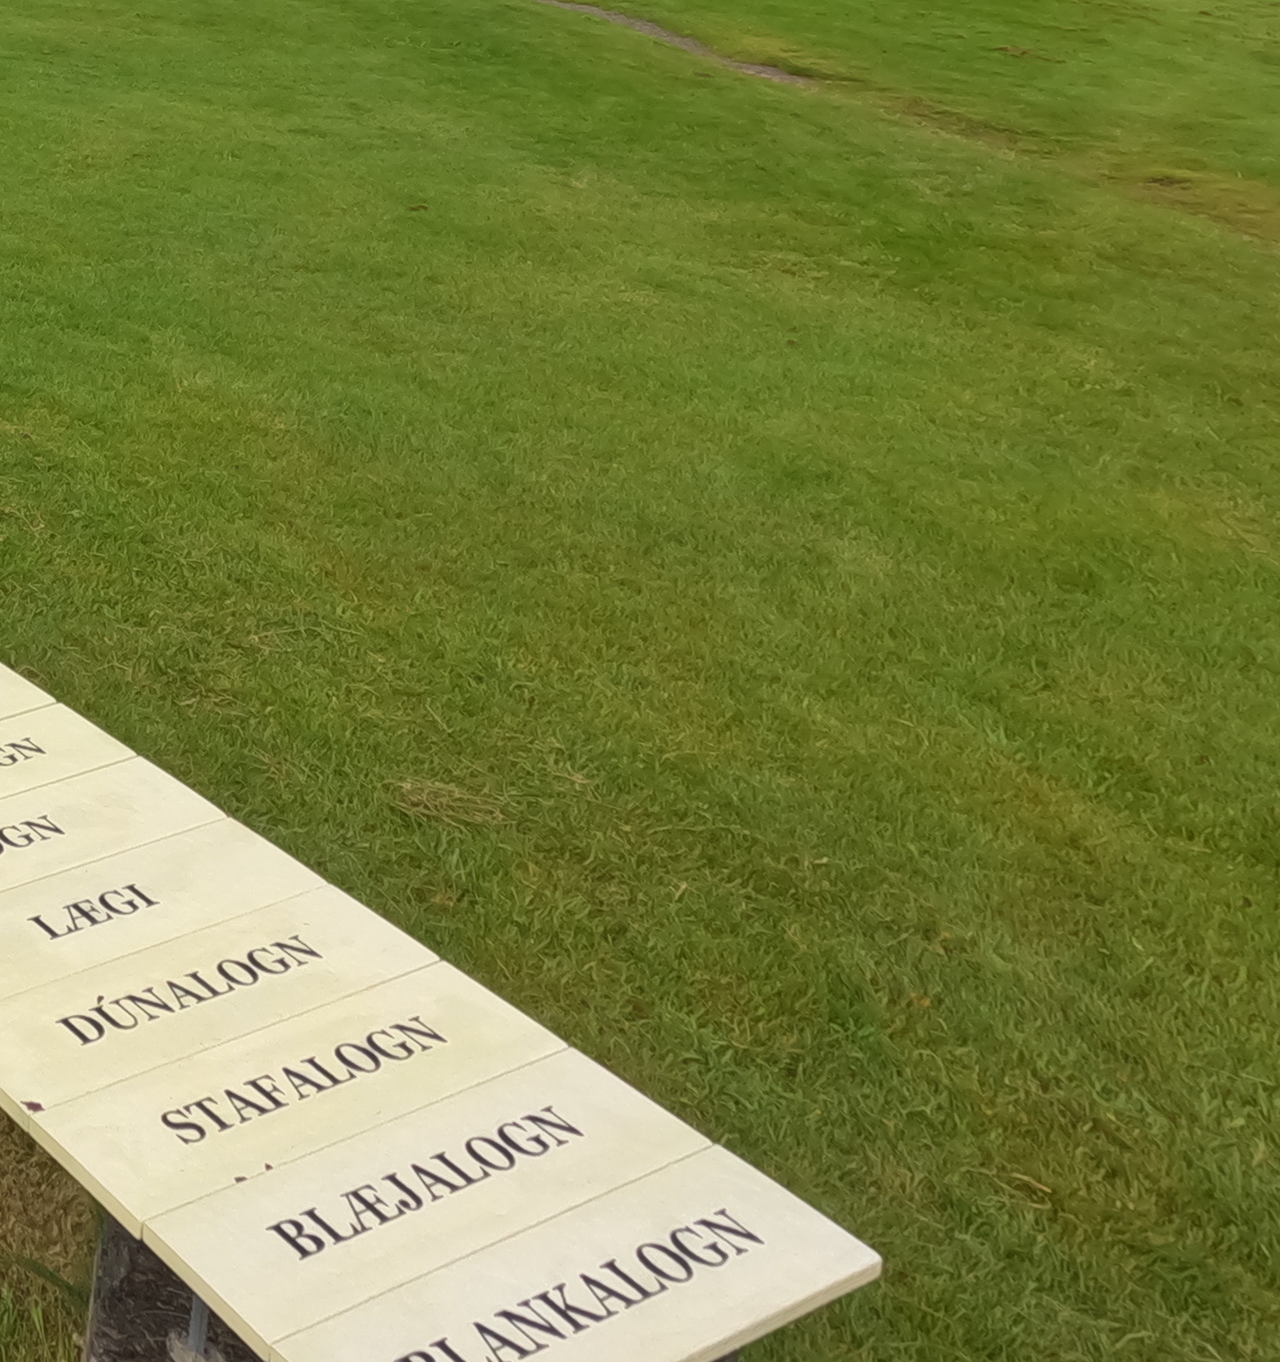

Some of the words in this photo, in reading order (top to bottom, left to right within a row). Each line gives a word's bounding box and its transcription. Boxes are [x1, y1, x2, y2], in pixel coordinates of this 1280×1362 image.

[27, 883, 159, 940] LÆGI
[55, 934, 323, 1046] DÚNALOGN
[160, 1016, 448, 1145] STAFALOGN
[266, 1105, 584, 1261] BLÆJALOGN
[395, 1207, 766, 1362] LANKALOGN
